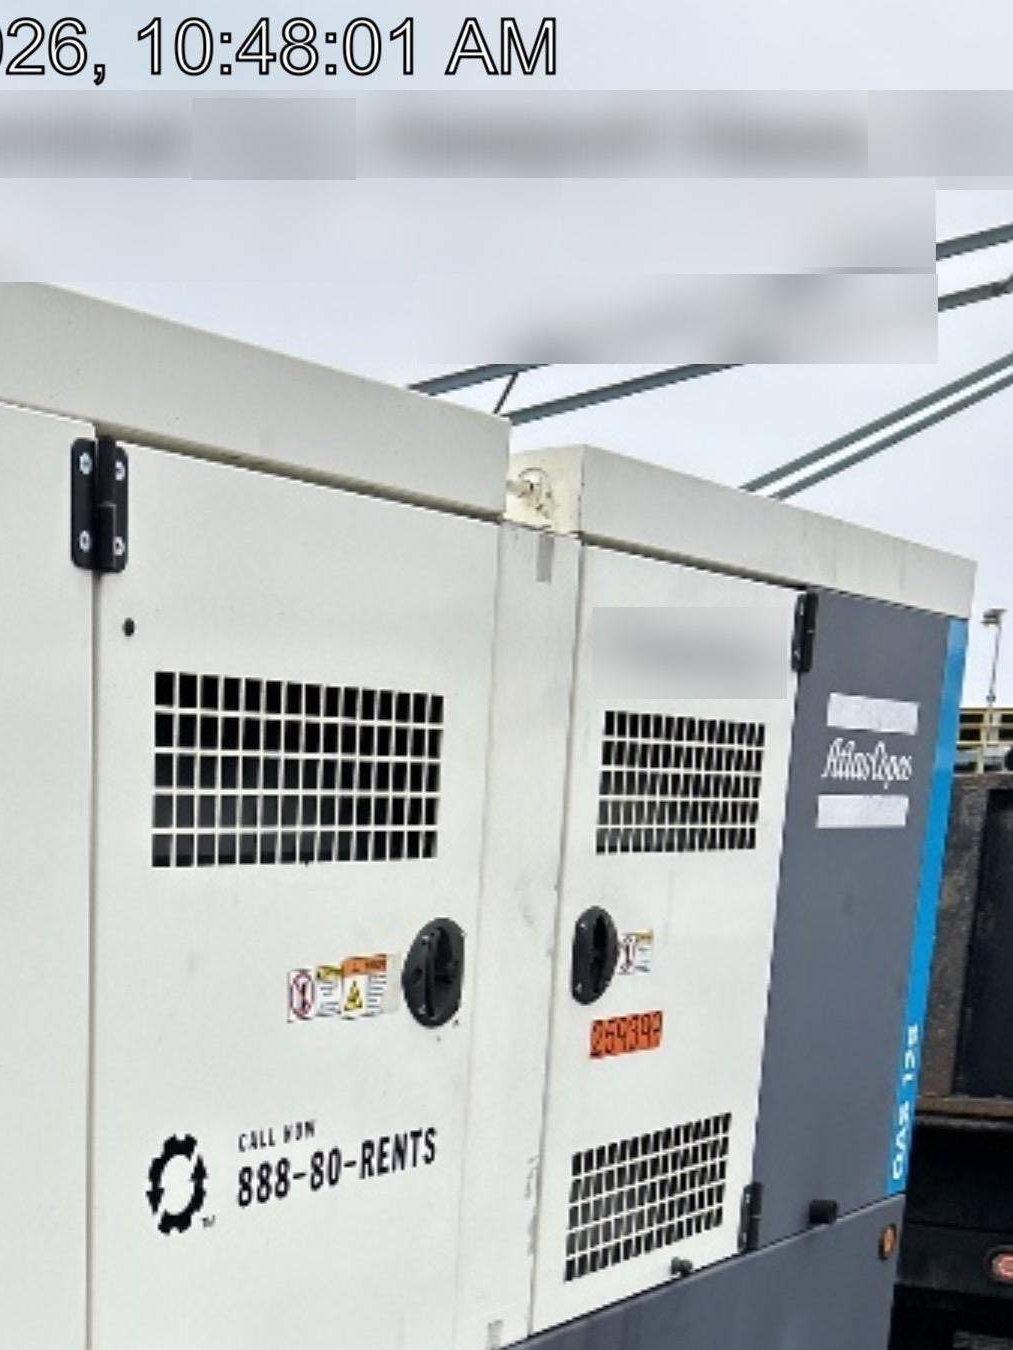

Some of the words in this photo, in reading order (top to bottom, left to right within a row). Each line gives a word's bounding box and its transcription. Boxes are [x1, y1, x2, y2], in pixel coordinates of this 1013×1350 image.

[821, 737, 868, 781] Atlas
[238, 1127, 276, 1152] CALL
[284, 1120, 316, 1144] NOW
[237, 1126, 438, 1208] 888-80-RENTS
